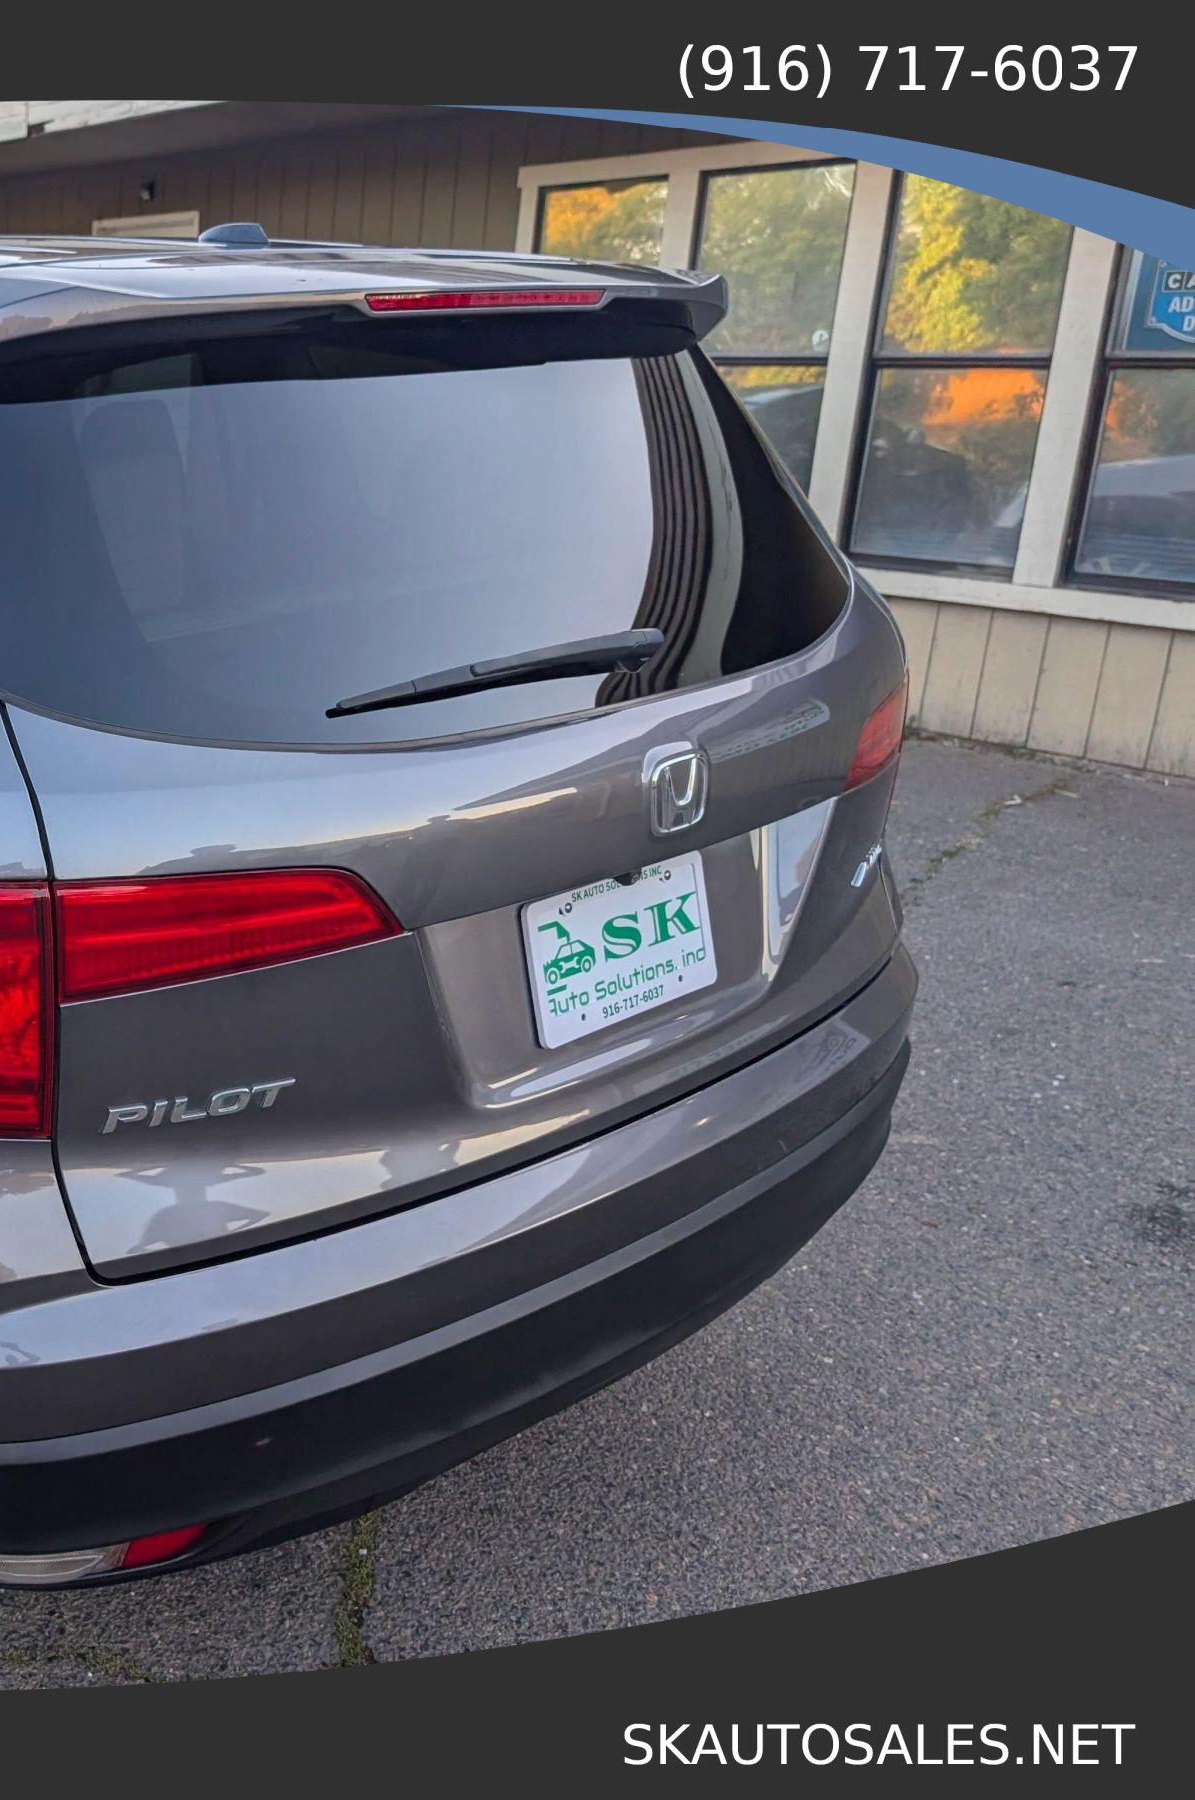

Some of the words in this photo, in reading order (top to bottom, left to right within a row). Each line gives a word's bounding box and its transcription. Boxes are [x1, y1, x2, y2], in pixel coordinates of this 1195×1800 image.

[571, 891, 583, 903] SK
[583, 884, 605, 900] AUTO
[649, 865, 662, 878] INC
[601, 890, 701, 962] SK
[602, 984, 665, 1019] 916-717-6037
[101, 1076, 297, 1134] PILOT
